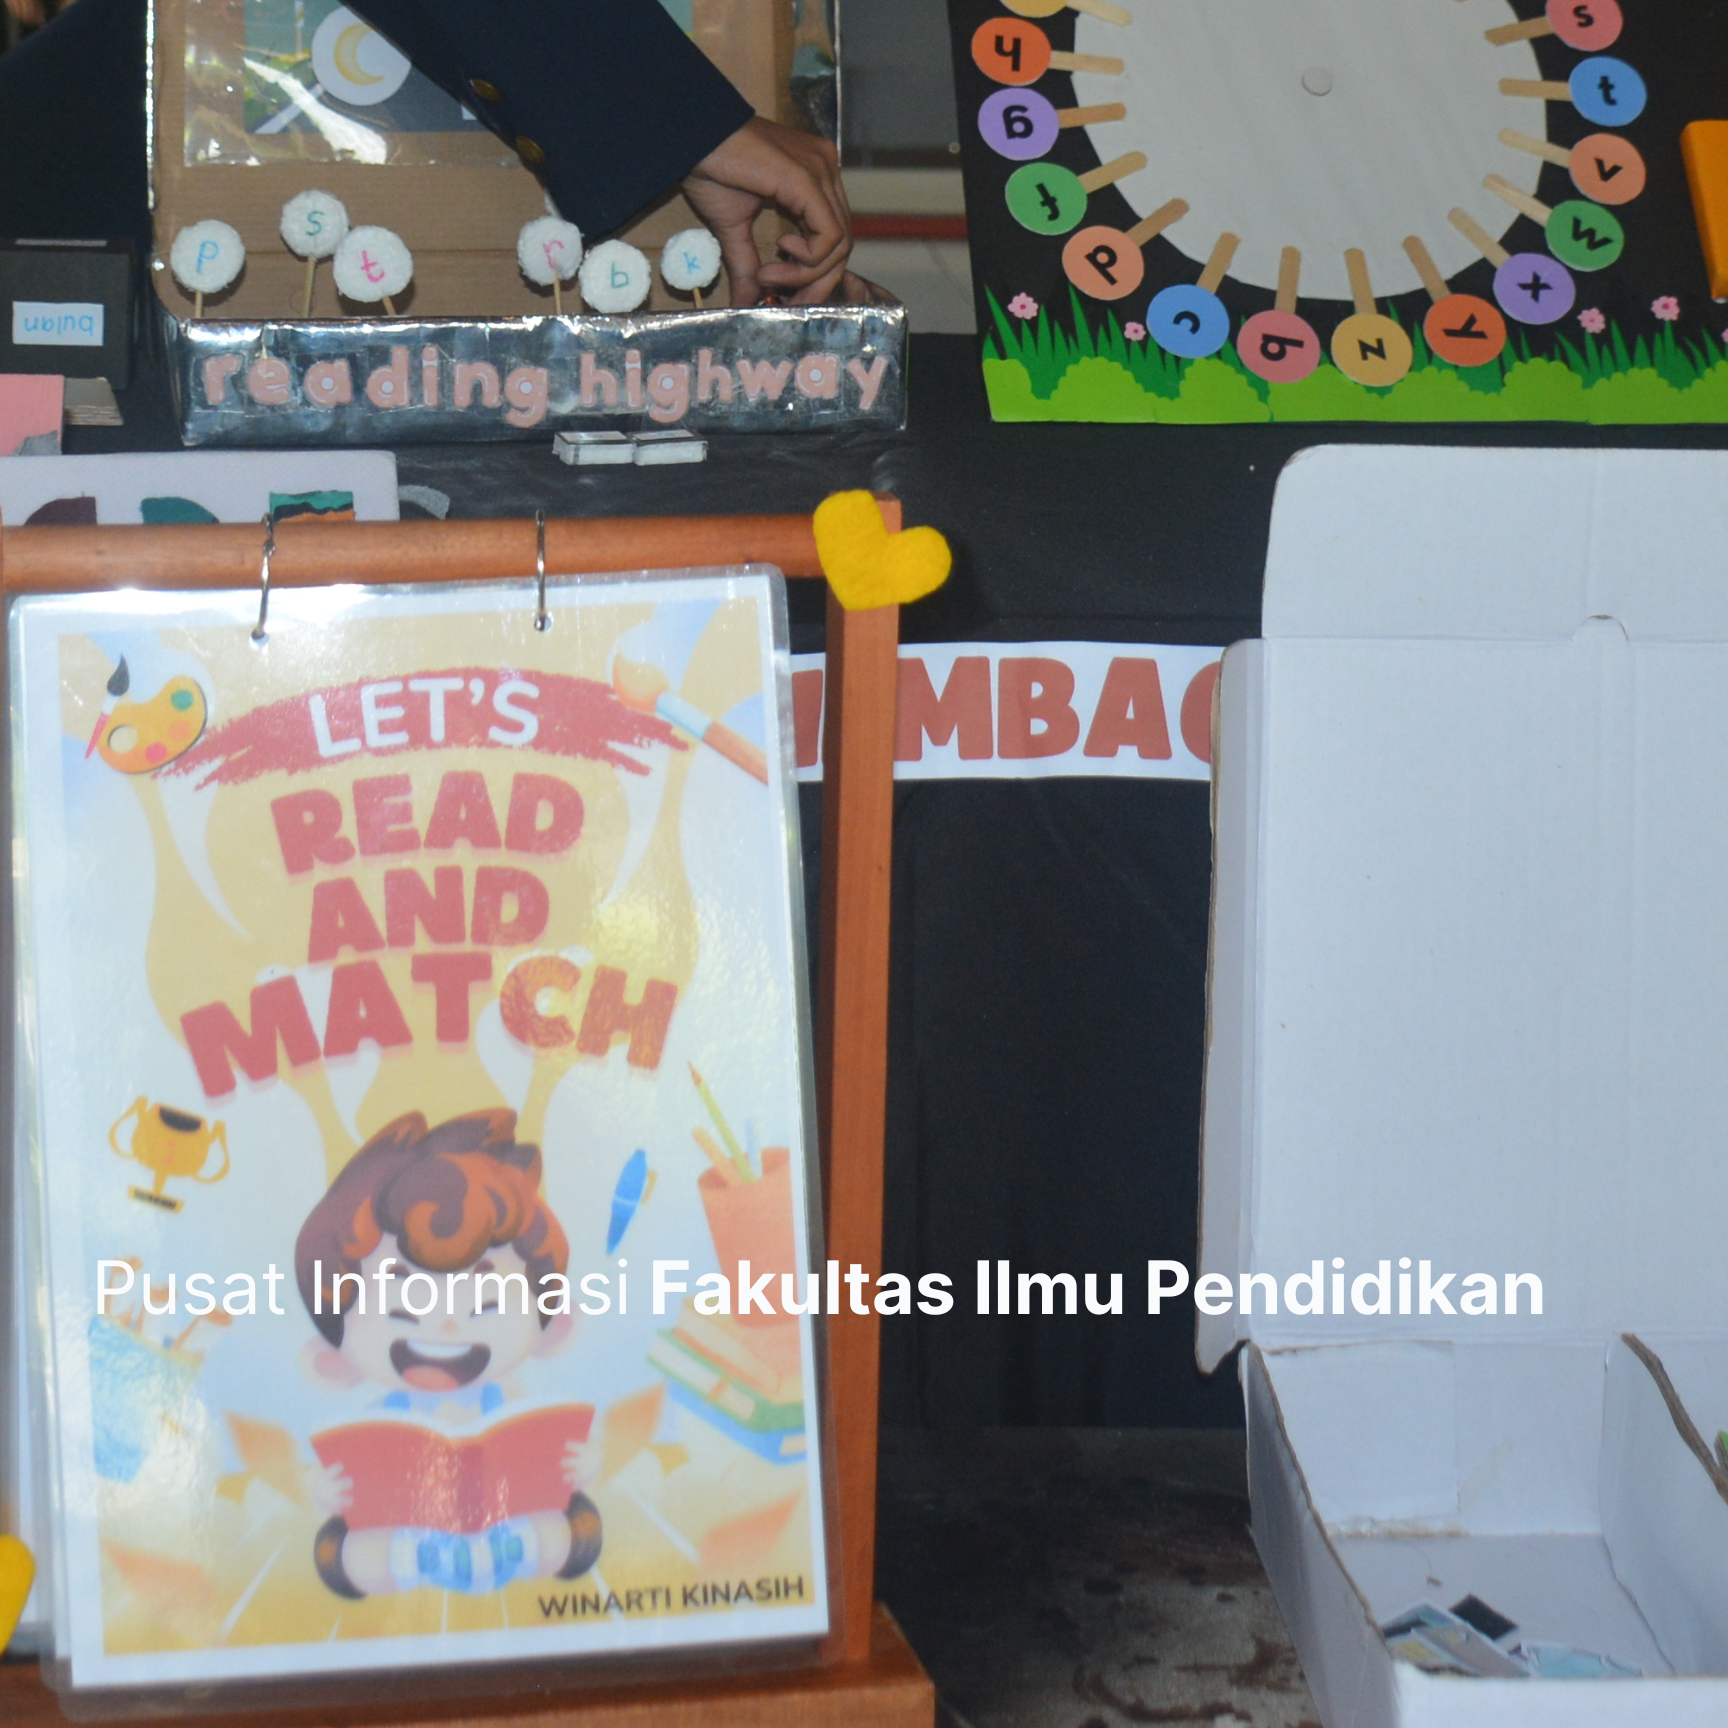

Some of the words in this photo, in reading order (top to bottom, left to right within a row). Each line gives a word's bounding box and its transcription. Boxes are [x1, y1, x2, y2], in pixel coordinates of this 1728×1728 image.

[24, 314, 94, 337] bulan
[202, 346, 548, 428] reading
[579, 348, 889, 424] highway
[309, 677, 539, 758] LET'S
[271, 770, 584, 872] READ
[307, 865, 549, 963] AND
[180, 951, 678, 1098] MATCH
[538, 1587, 671, 1620] WINARTI
[681, 1575, 805, 1610] KINASIH
